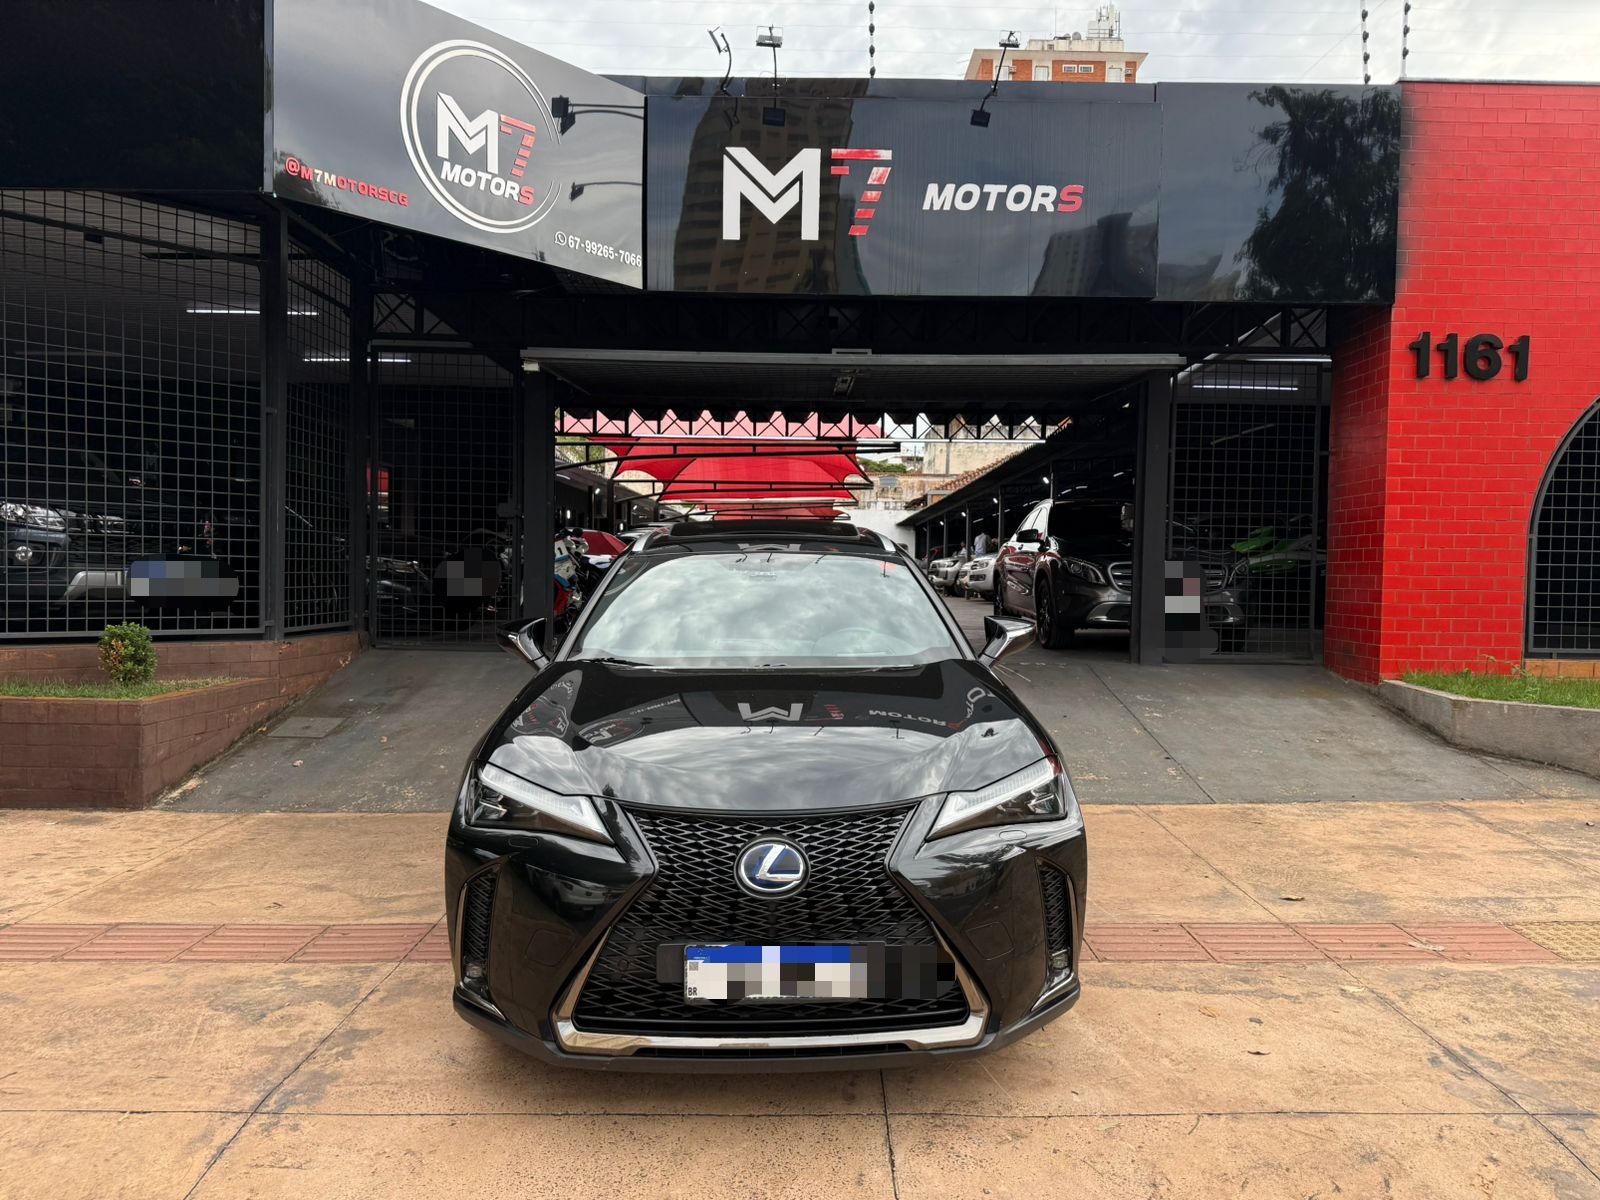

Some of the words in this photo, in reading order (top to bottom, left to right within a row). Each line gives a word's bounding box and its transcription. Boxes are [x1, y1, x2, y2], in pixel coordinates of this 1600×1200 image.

[437, 92, 536, 177] M7
[285, 157, 409, 207] @M7MOTORSCG
[440, 160, 535, 206] MOTORS
[722, 147, 893, 241] M7
[922, 183, 1084, 213] MOTORS
[568, 235, 642, 268] 67-99265-7066
[1408, 331, 1530, 383] 1161
[687, 986, 698, 997] BR
